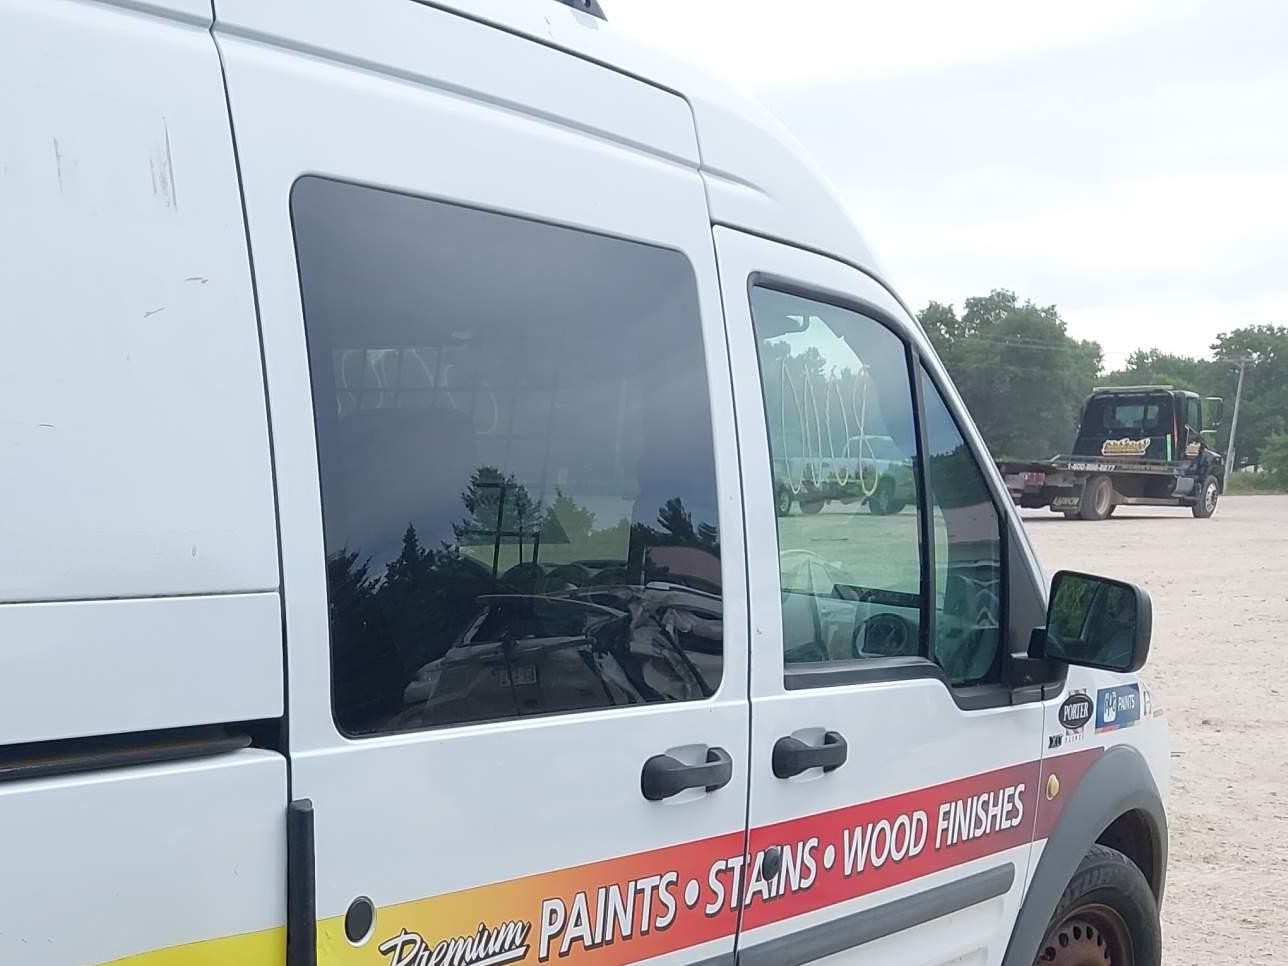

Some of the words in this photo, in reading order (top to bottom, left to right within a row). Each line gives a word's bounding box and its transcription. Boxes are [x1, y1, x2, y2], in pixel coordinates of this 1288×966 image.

[1063, 702, 1089, 721] PORTER
[1117, 694, 1135, 712] PAINTS
[537, 870, 679, 962] PAINTS
[842, 810, 929, 877] WOOD
[934, 783, 1026, 850] FINISHES
